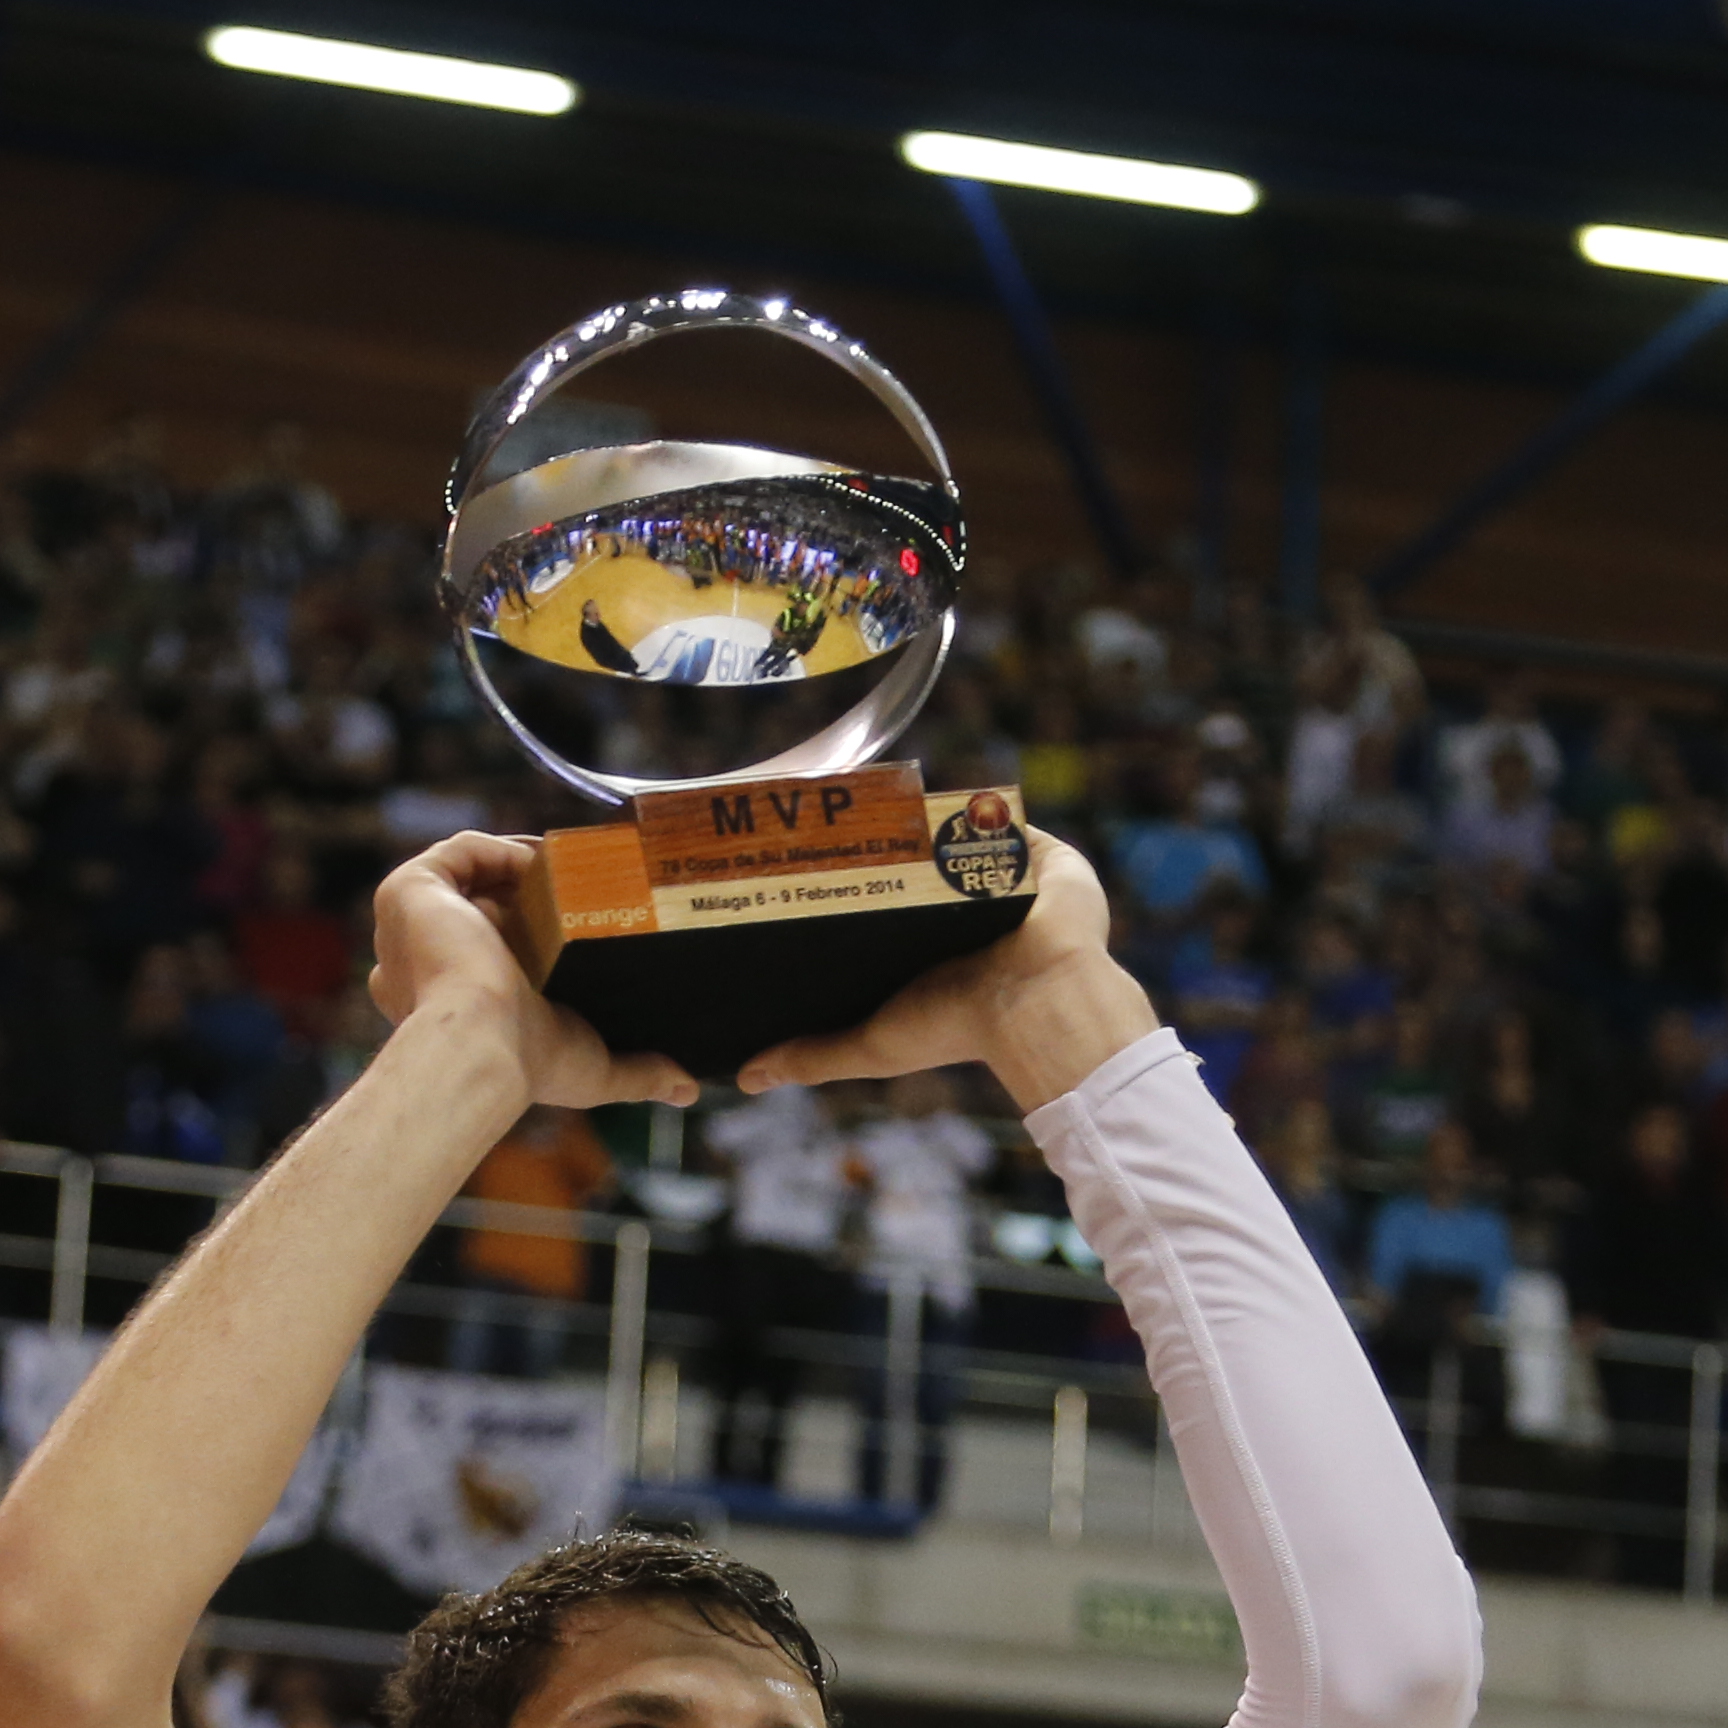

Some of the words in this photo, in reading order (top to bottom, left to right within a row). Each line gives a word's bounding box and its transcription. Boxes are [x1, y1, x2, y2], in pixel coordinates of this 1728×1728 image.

[945, 854, 997, 873] COPA
[961, 867, 1016, 892] REY
[690, 893, 751, 912] Málaga
[780, 888, 791, 902] 9
[795, 884, 861, 901] Febrero
[866, 878, 906, 895] 2014
[561, 904, 650, 929] orange
